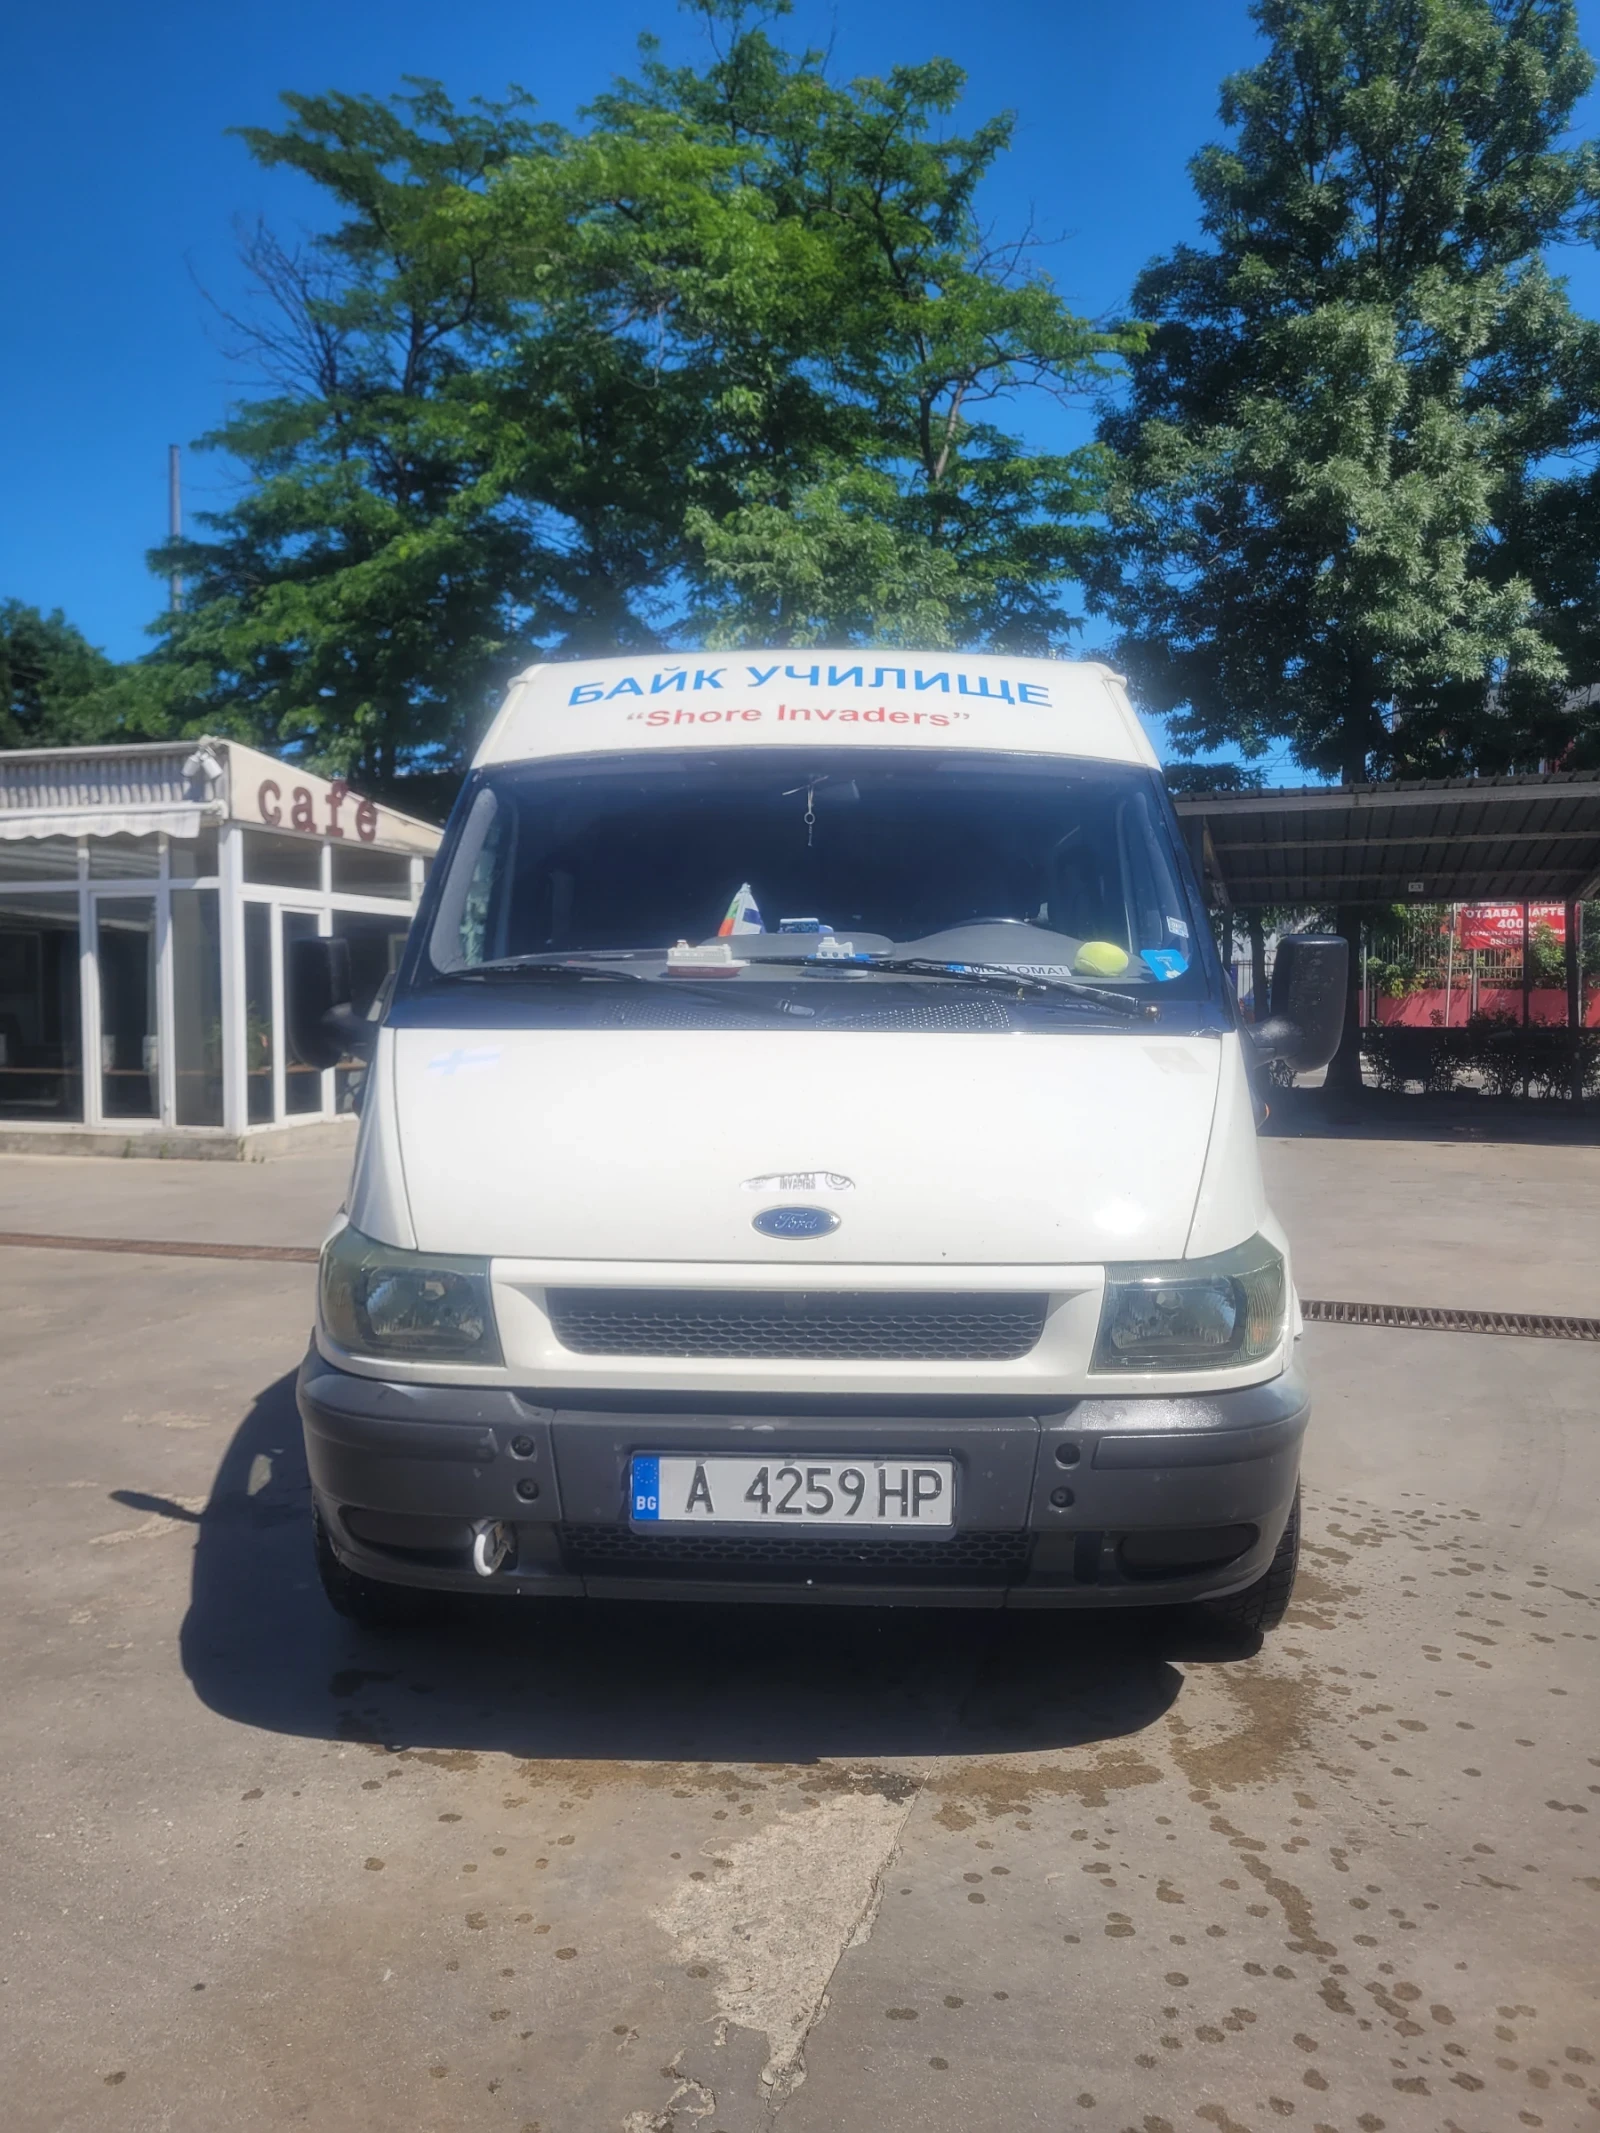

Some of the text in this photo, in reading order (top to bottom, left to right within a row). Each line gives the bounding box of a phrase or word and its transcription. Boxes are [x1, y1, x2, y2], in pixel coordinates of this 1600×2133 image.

[568, 665, 1052, 708] БАЙК УЧИЛИЩЕ
[258, 779, 377, 843] cafe
[775, 1212, 818, 1229] Ford
[636, 1495, 657, 1511] BG
[685, 1466, 715, 1513] A
